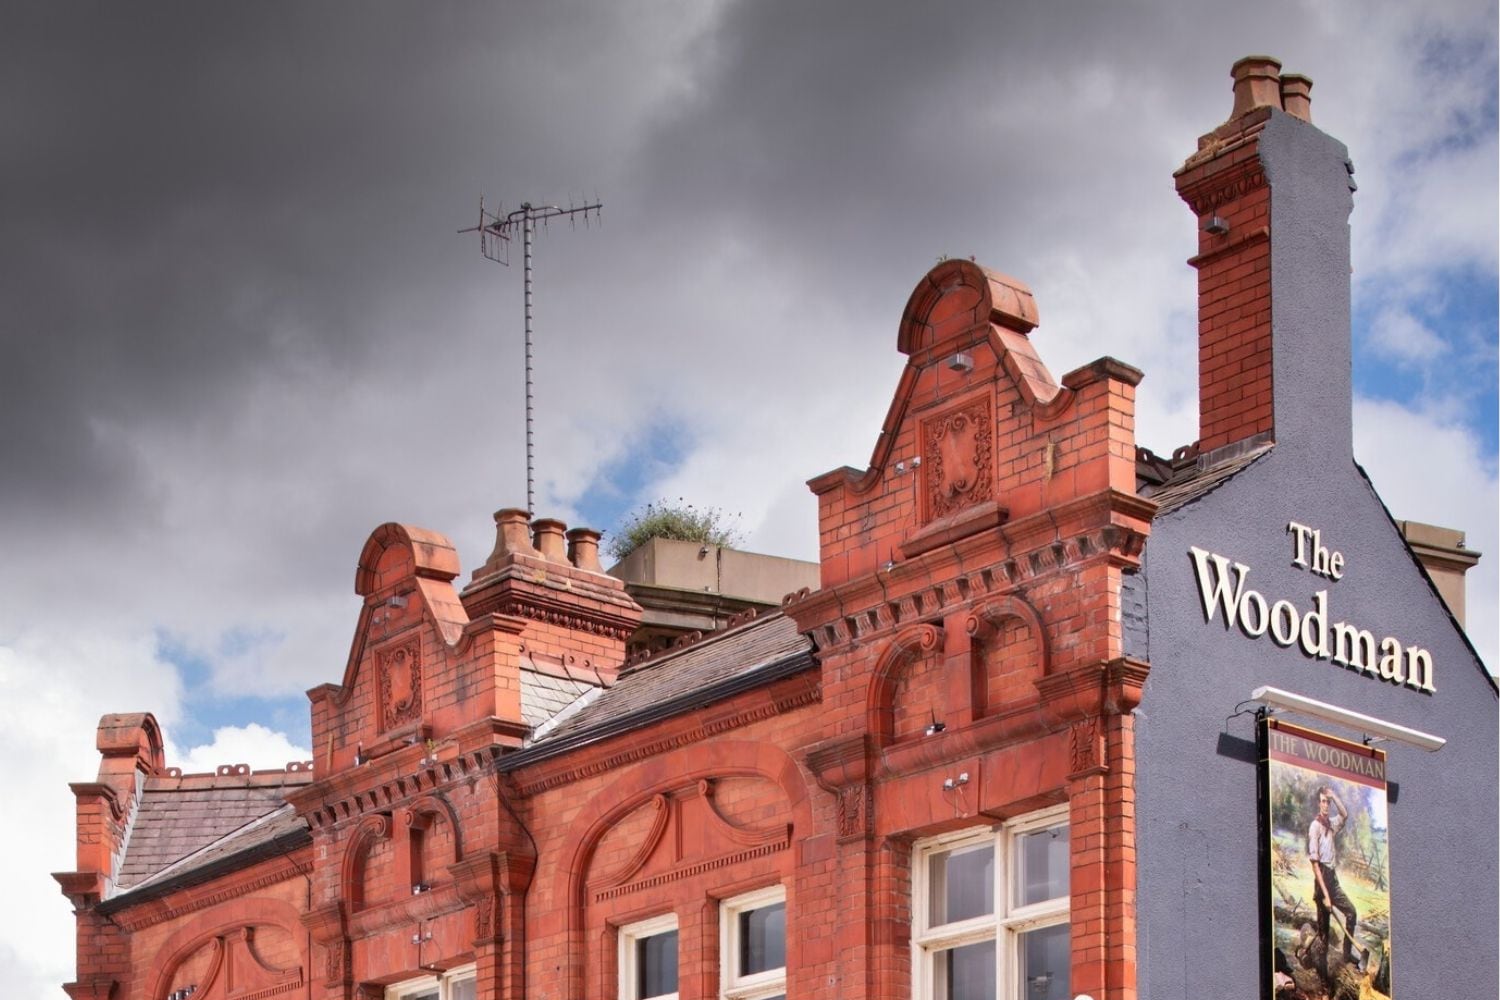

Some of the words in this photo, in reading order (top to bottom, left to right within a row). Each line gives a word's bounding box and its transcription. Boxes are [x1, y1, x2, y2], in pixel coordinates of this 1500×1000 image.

[1287, 521, 1345, 580] The
[1190, 545, 1438, 693] Woodman
[1270, 732, 1299, 757] THE
[1303, 740, 1385, 779] WOODMAN
